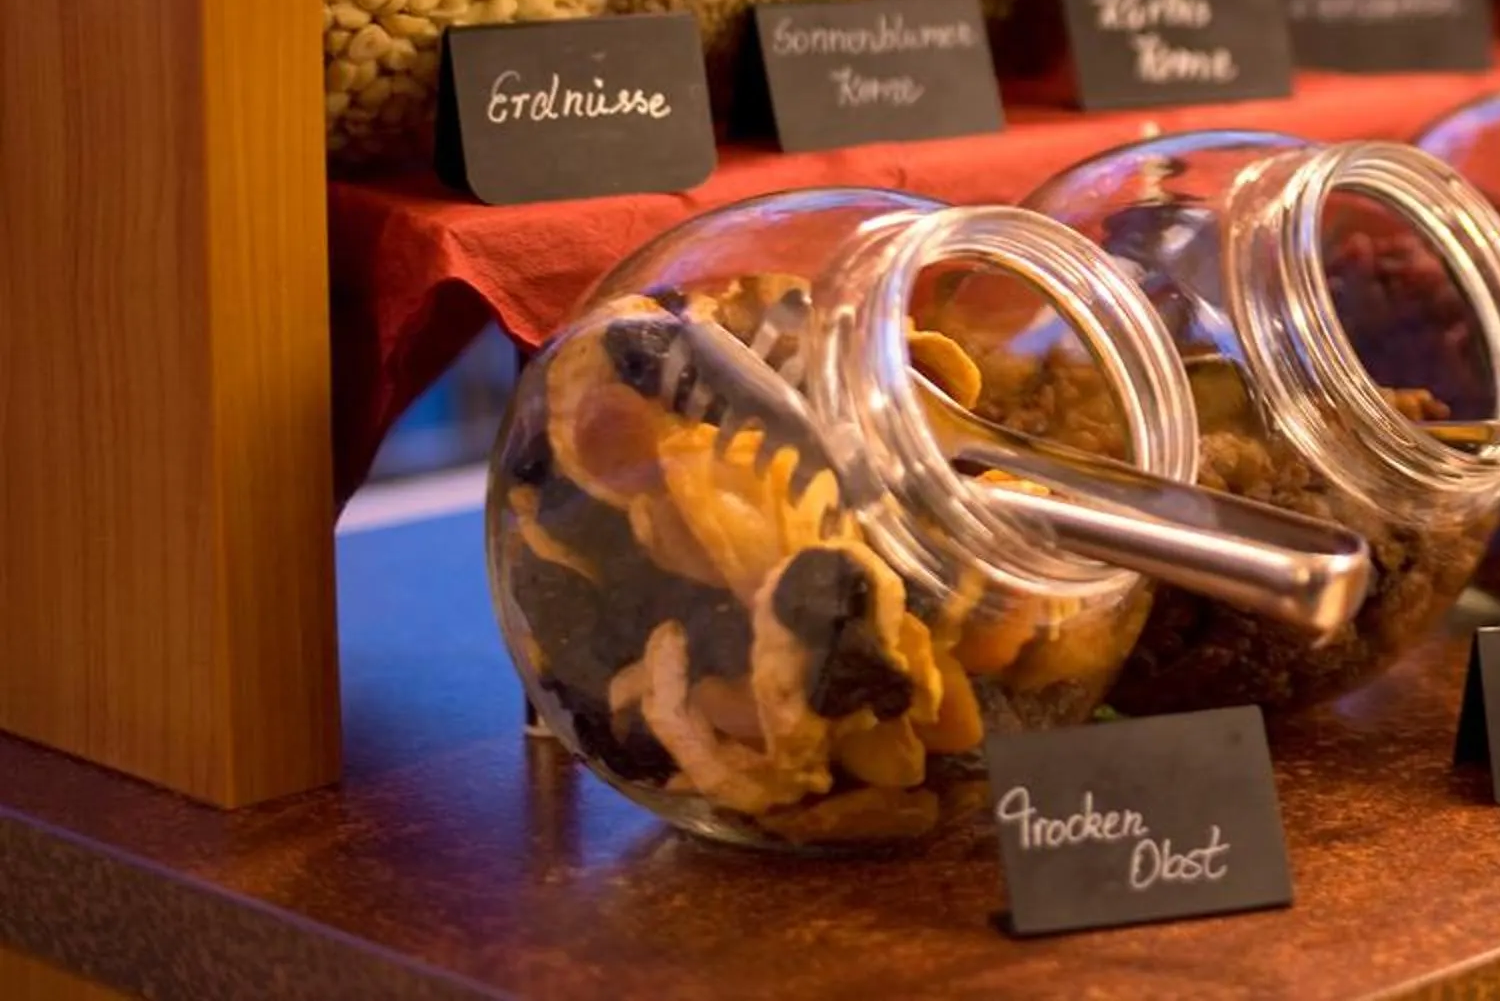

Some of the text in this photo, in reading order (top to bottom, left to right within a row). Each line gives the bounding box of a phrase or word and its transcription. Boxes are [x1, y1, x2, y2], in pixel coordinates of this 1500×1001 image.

[487, 70, 672, 124] Erdnüsse
[996, 785, 1149, 850] Trocken
[1129, 824, 1231, 890] Obst
